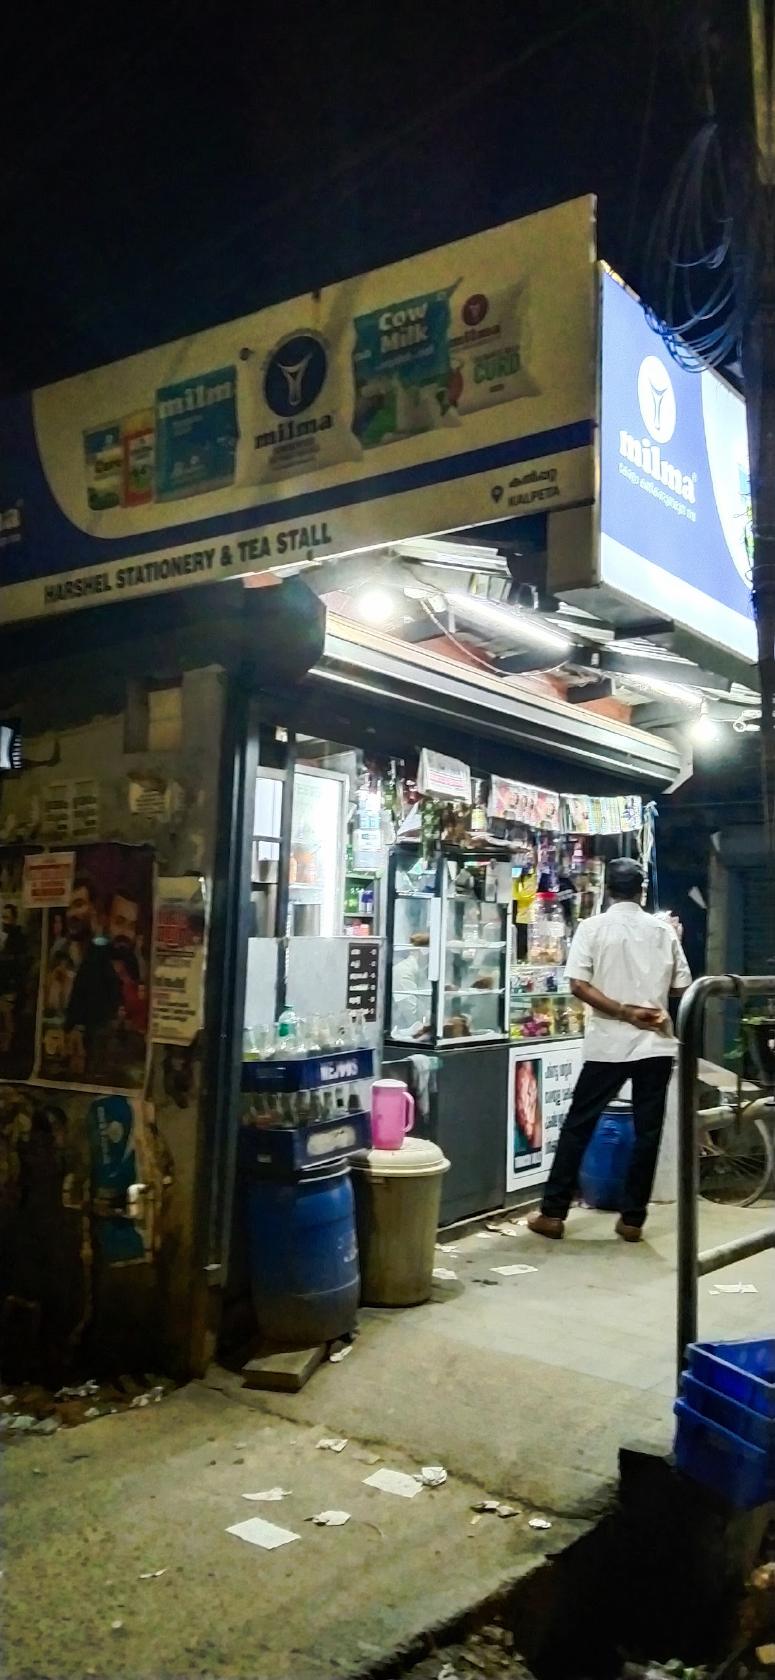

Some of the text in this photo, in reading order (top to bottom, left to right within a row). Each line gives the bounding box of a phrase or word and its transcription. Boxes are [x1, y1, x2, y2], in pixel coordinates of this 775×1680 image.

[378, 302, 429, 331] Cow
[380, 323, 430, 353] Milk
[254, 414, 334, 450] milma
[618, 430, 697, 504] milma
[508, 486, 561, 507] KALPETA
[44, 522, 333, 604] HARSHEL STATIONERY & TEA STALL
